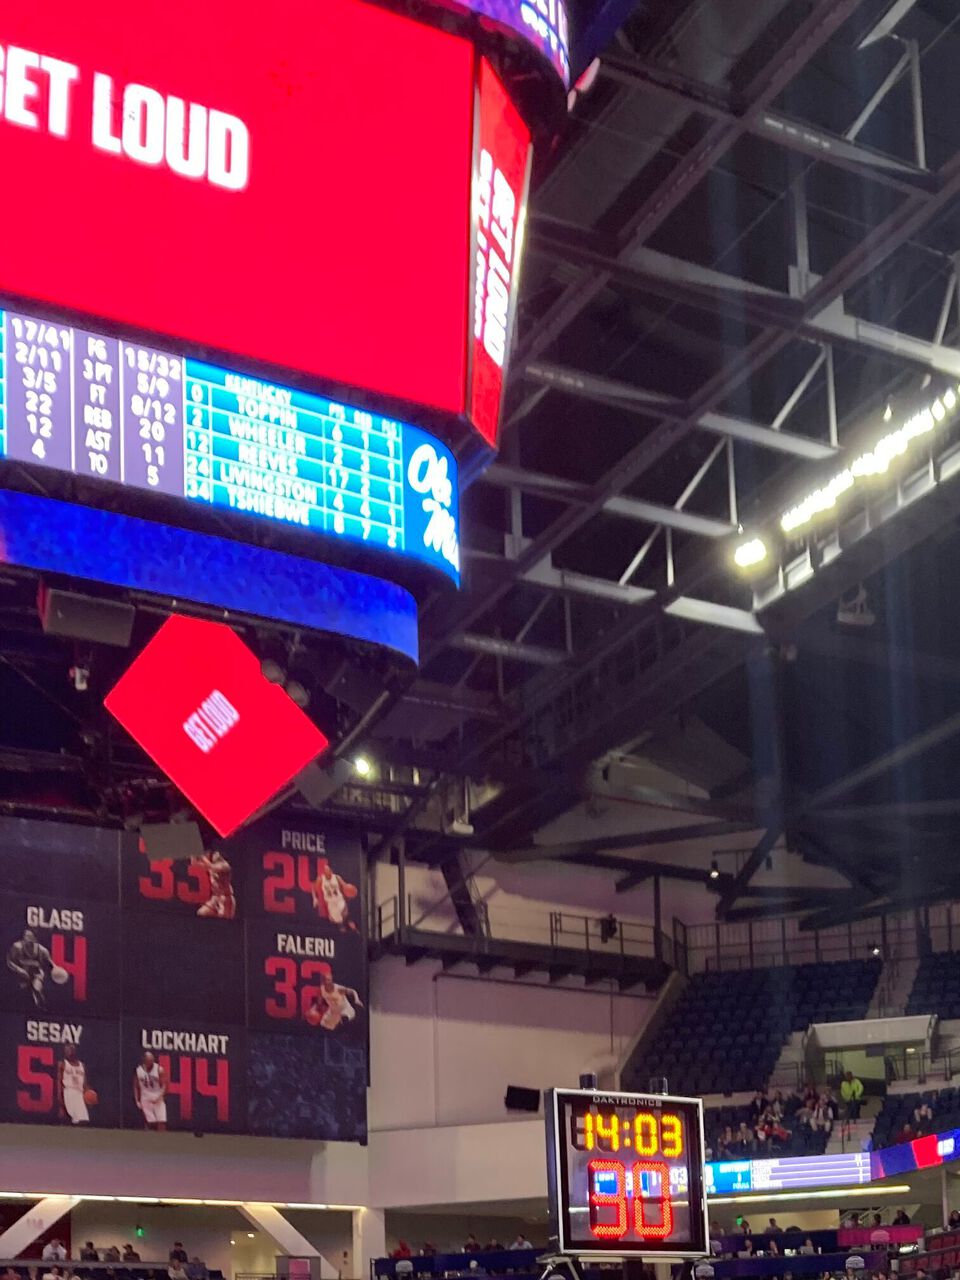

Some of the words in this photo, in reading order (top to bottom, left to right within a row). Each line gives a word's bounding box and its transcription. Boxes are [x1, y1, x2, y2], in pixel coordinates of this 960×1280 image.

[0, 45, 81, 140] ET
[92, 71, 249, 191] LOUD
[12, 318, 70, 350] 17/41
[15, 342, 62, 372] 2/11
[22, 367, 57, 393] 3/5
[25, 390, 52, 415] 22
[26, 413, 52, 438] 12
[139, 417, 165, 442] 20
[191, 383, 203, 402] 0
[236, 395, 297, 429] TOPPIN
[361, 432, 370, 450] 1
[387, 439, 395, 458] 1
[32, 438, 46, 459] 4
[85, 428, 112, 452] AST
[192, 407, 203, 427] 2
[229, 415, 306, 455] WHEELER
[387, 462, 395, 480] 1
[142, 443, 165, 466] 11
[188, 431, 208, 453] 12
[239, 444, 298, 476] REEVES
[329, 468, 349, 490] 17
[388, 485, 396, 503] 1
[147, 464, 160, 486] 5
[187, 478, 210, 500] 34
[187, 456, 209, 476] 24
[220, 462, 317, 504] LIVINGSTON
[388, 507, 396, 526] 1
[281, 829, 326, 853] PRICE
[262, 851, 329, 918] 24
[26, 906, 84, 932] GLASS
[277, 933, 335, 959] FALERU
[51, 933, 88, 1001] 4
[264, 956, 331, 1023] 32
[26, 1020, 82, 1045] SESAY
[141, 1029, 229, 1055] LOCKHART
[16, 1045, 54, 1113] 5
[158, 1055, 229, 1122] 44
[593, 1096, 662, 1107] DAKTRONICS
[584, 1112, 683, 1158] 14:03
[588, 1159, 673, 1239] 30
